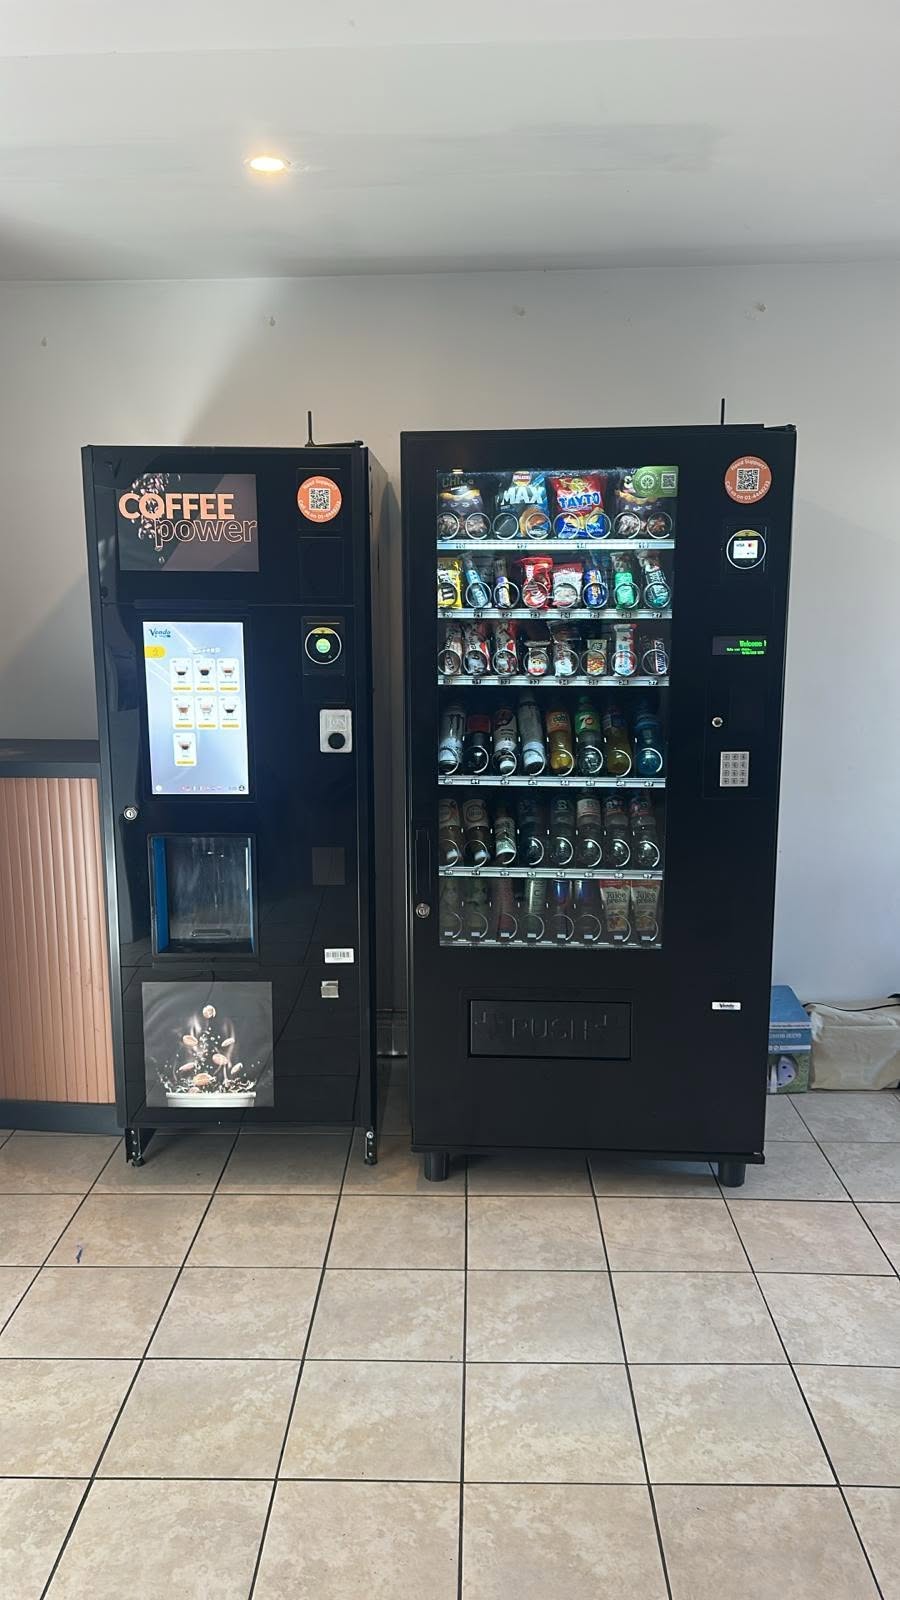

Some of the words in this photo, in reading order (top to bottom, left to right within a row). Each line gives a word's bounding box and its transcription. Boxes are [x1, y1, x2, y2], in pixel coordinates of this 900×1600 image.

[118, 493, 235, 520] COFFEE
[501, 485, 545, 505] MAX
[558, 492, 602, 508] TAYTO
[154, 519, 258, 548] power
